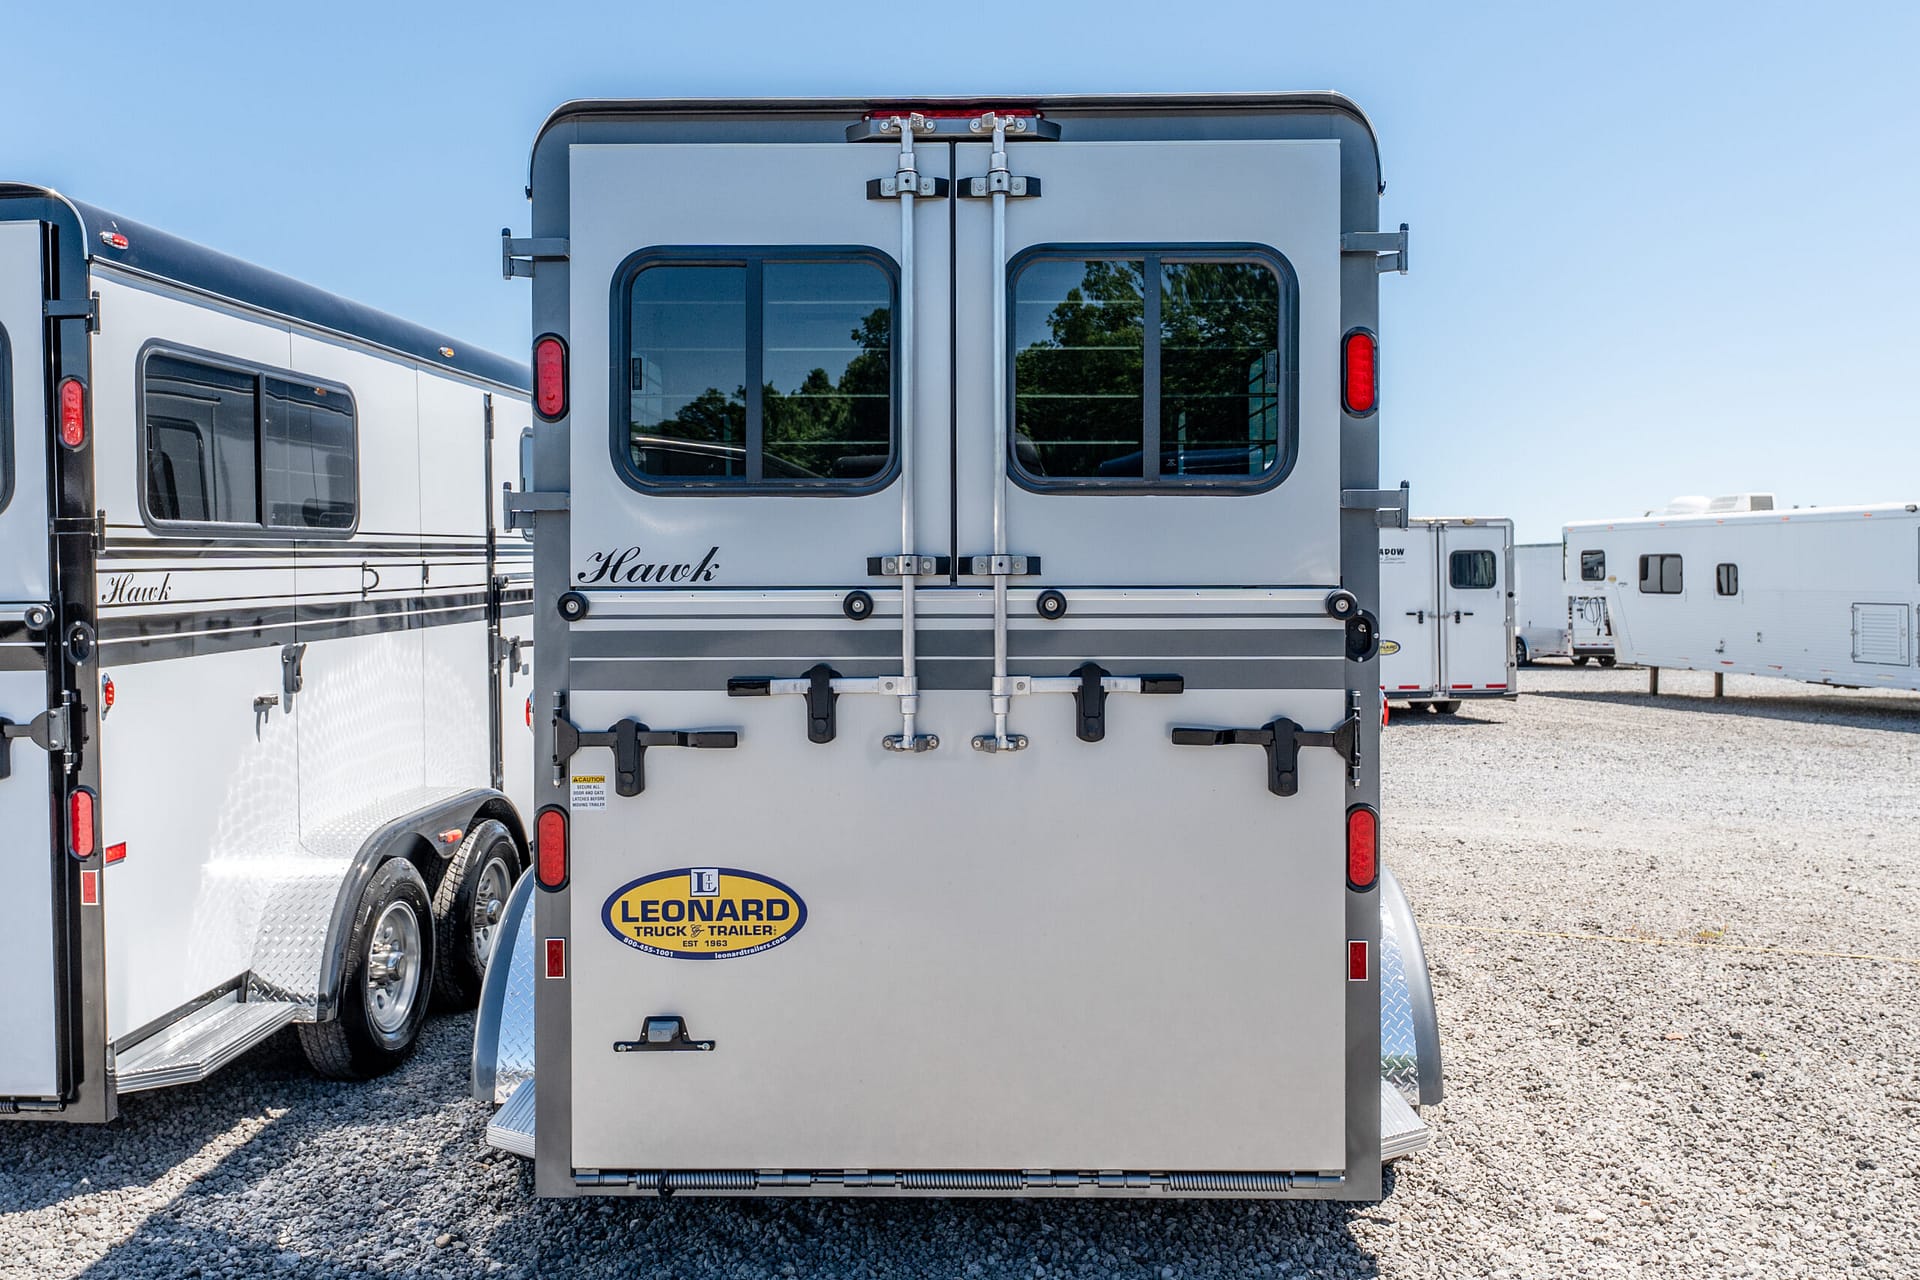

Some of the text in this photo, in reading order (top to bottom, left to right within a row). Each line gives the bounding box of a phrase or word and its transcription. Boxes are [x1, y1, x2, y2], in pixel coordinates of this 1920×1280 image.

[577, 546, 720, 583] Hawk
[101, 572, 172, 603] Hawk
[621, 899, 790, 923] LEONARD
[634, 925, 687, 937] TRUCK
[708, 925, 773, 936] TRAILER
[704, 939, 728, 947] 1963
[623, 937, 674, 958] 800-455-1001
[714, 935, 787, 959] leonardtrailers.com
